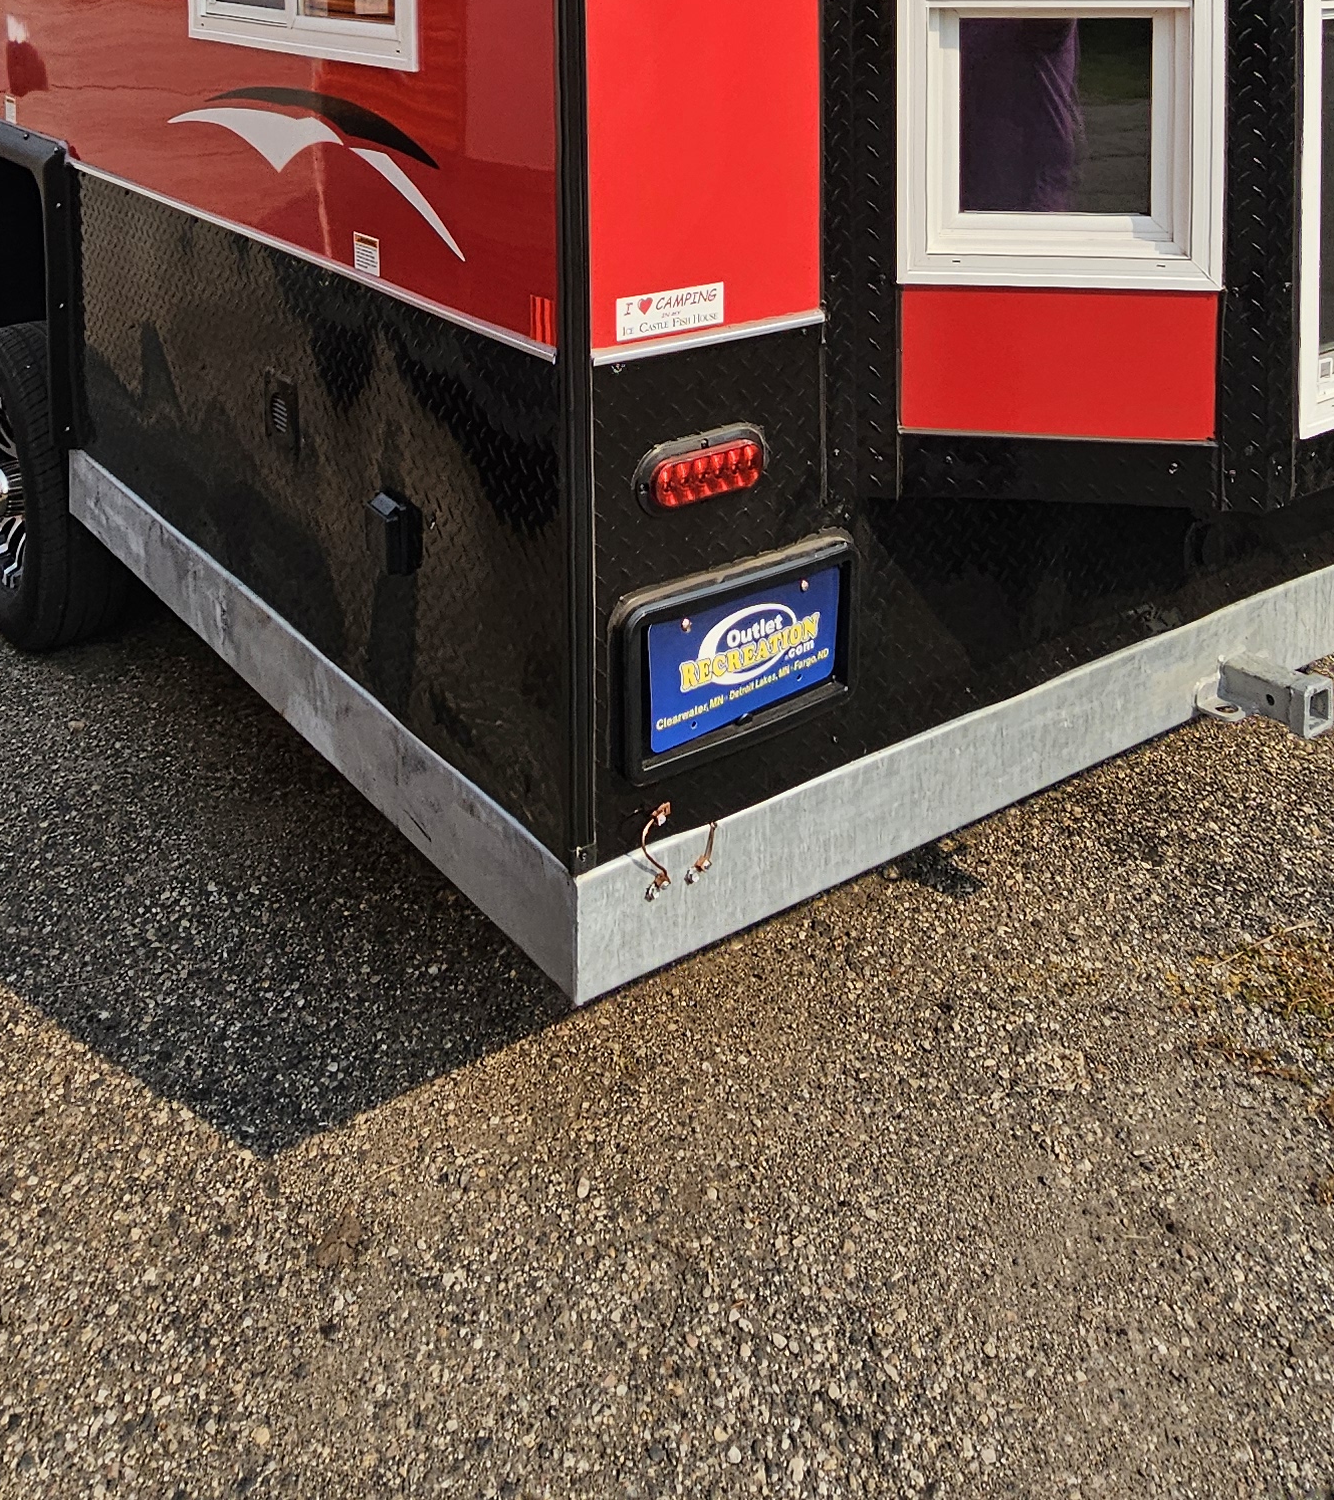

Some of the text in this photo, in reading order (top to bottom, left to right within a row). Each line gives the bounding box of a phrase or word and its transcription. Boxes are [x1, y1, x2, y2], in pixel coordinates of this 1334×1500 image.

[624, 288, 717, 316] I CAMPING
[727, 614, 783, 648] Outlet
[680, 611, 821, 693] RECREATION
[785, 640, 815, 661] .com
[710, 694, 724, 710] MN
